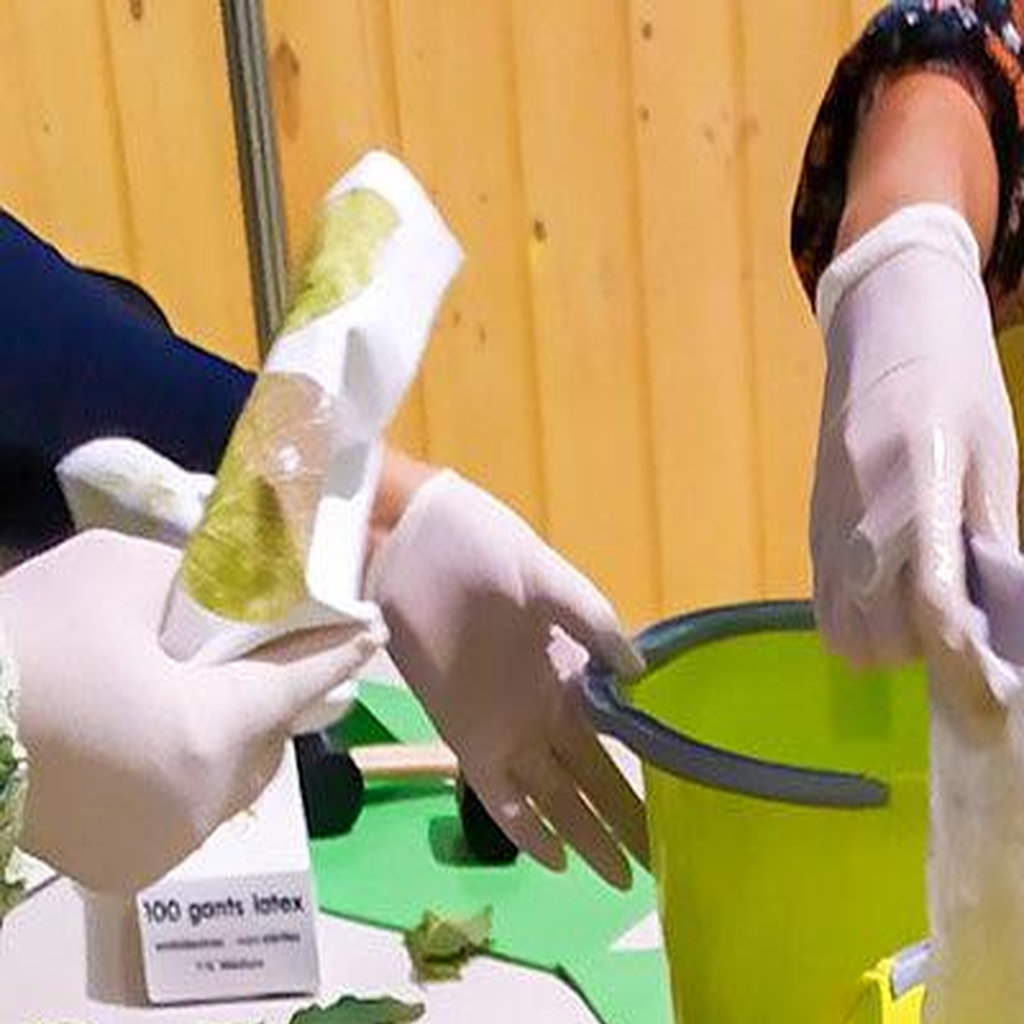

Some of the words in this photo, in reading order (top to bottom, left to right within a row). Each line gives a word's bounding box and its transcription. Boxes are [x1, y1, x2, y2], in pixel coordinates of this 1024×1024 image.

[144, 899, 182, 923] 100
[188, 897, 244, 926] gants
[252, 893, 305, 916] latex
